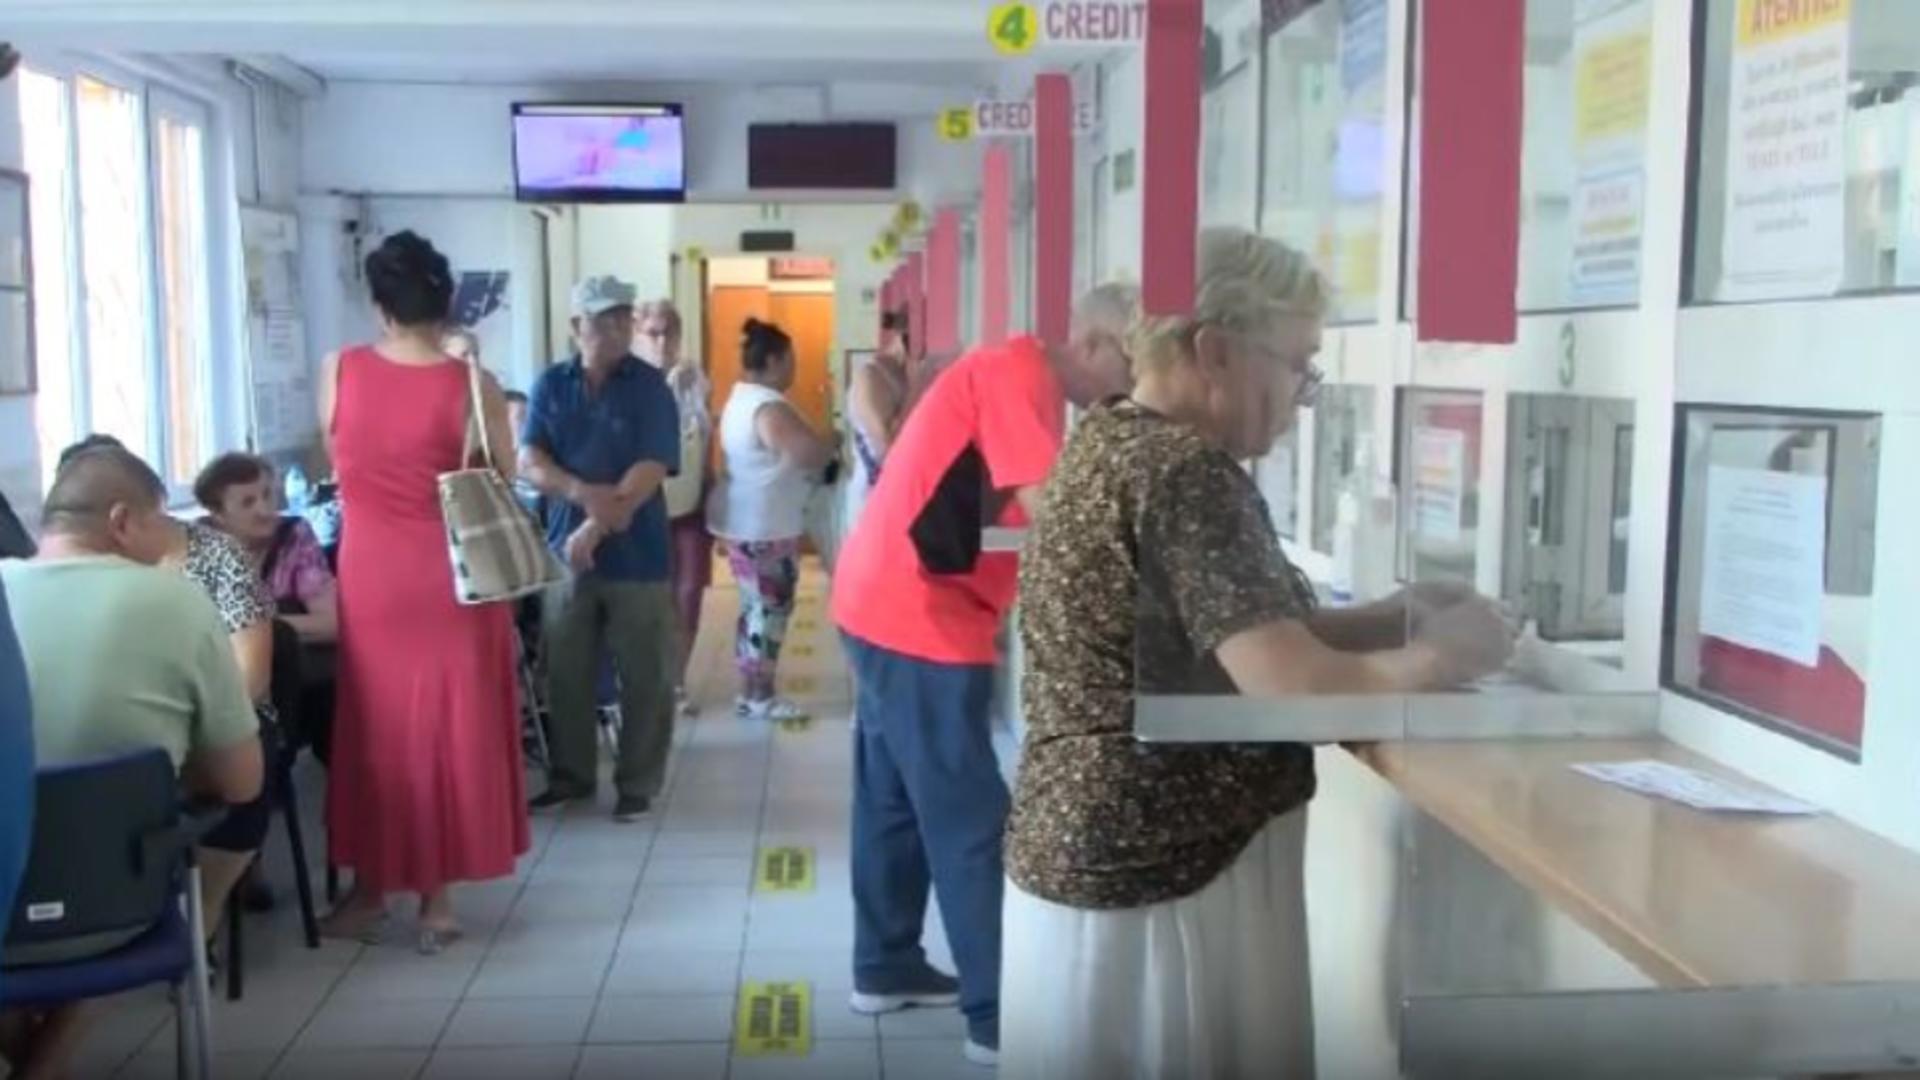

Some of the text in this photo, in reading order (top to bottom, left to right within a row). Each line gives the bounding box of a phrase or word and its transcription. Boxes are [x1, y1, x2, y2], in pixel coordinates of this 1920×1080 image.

[996, 2, 1147, 47] 4 CREDIT
[945, 109, 969, 139] 5
[1558, 322, 1576, 388] 3
